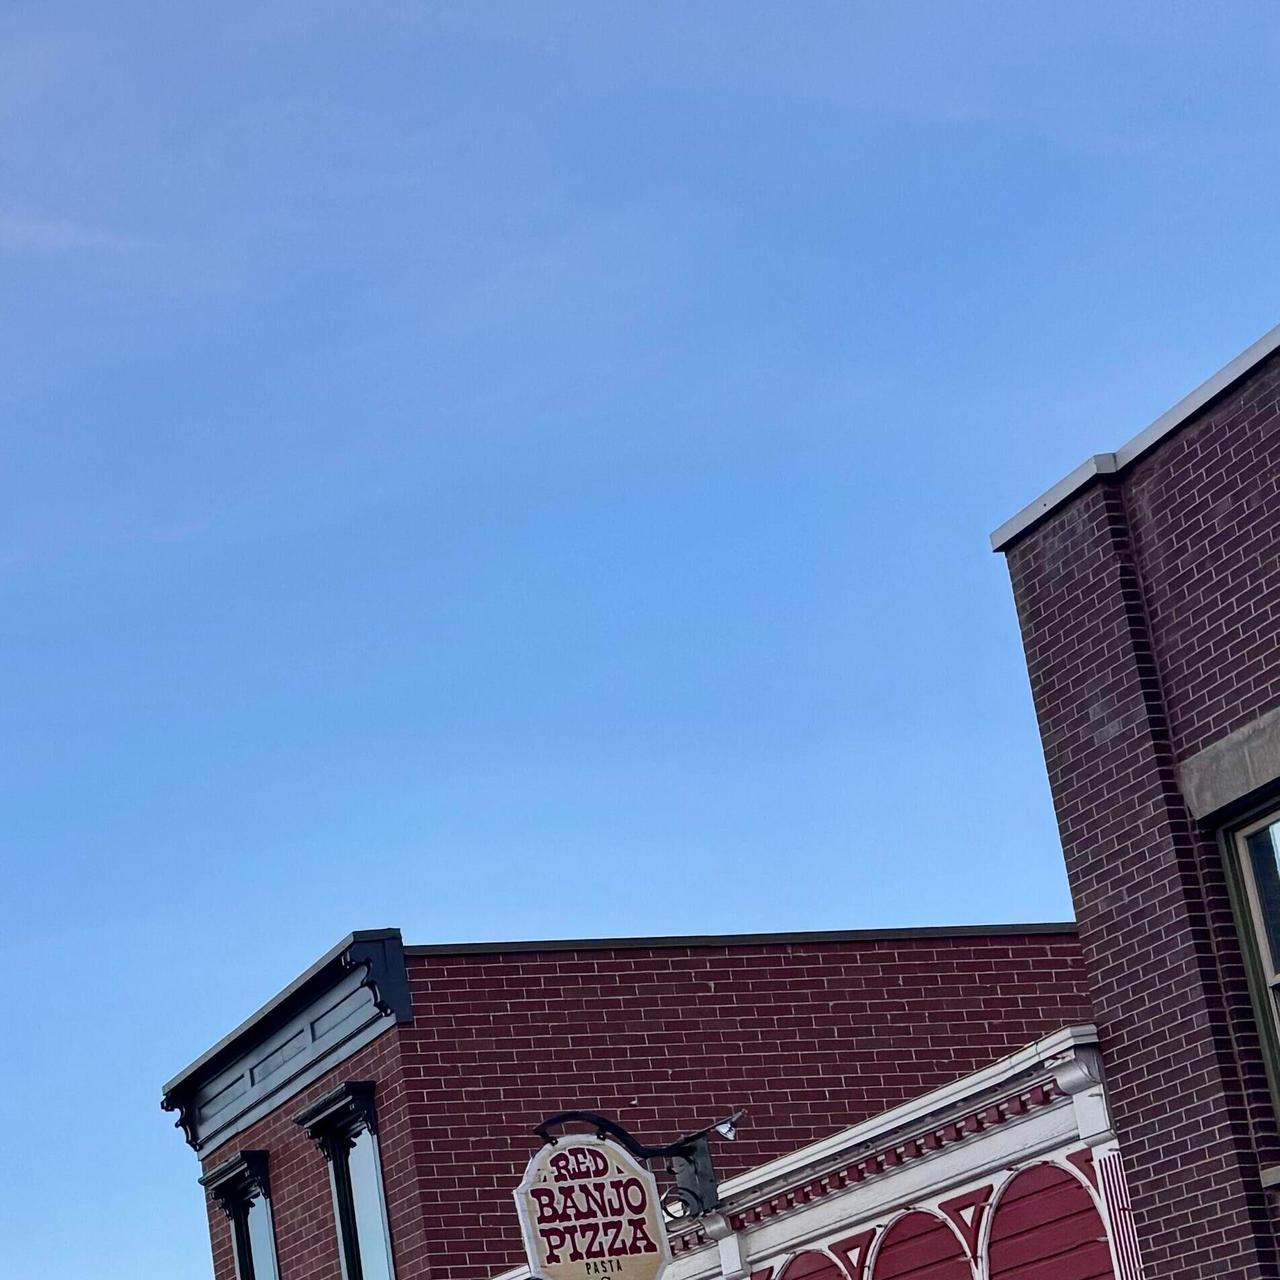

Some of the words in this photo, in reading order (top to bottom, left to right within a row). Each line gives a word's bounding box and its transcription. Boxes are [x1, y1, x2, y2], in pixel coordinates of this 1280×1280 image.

[549, 1147, 609, 1183] RED
[530, 1177, 647, 1224] BANJO
[539, 1217, 658, 1265] PIZZA
[585, 1259, 622, 1275] PASTA
